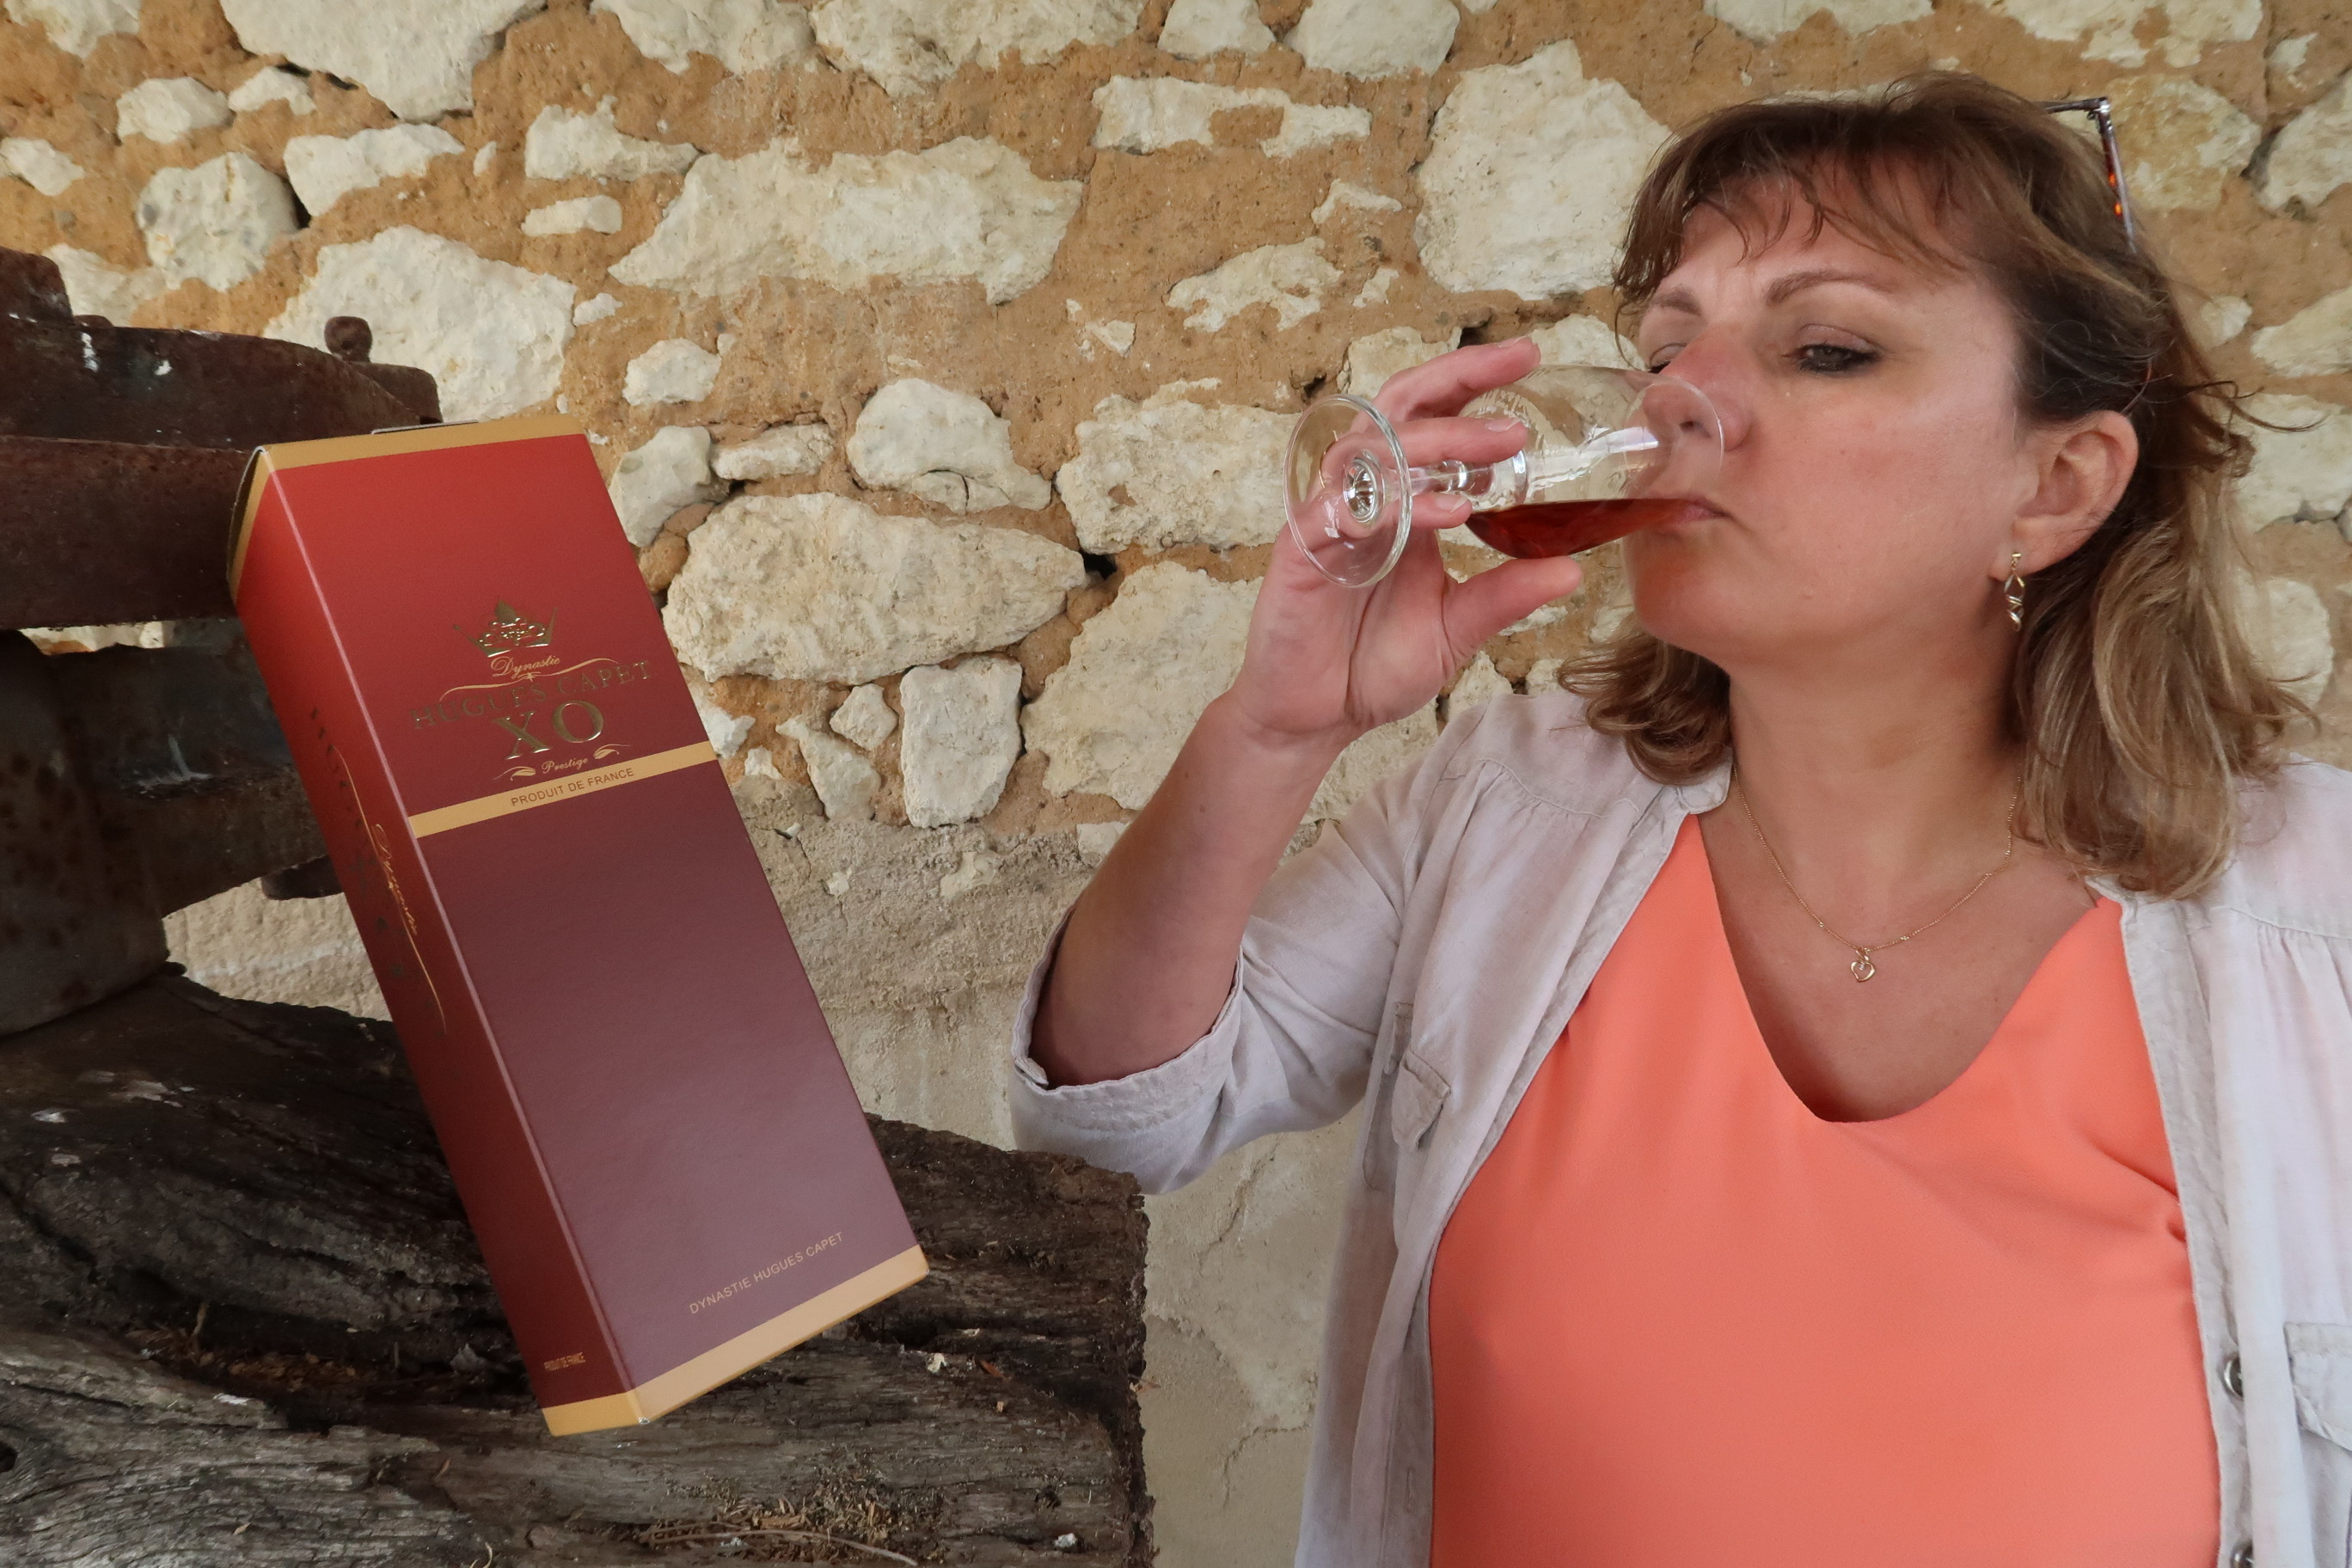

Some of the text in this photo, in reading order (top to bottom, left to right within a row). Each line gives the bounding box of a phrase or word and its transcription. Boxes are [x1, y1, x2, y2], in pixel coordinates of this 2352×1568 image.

[491, 654, 561, 680] Dynastie
[408, 659, 652, 730] HUGUES CAPET
[493, 699, 604, 760] XO
[511, 767, 634, 806] PRODUIT DE FRANCE
[541, 756, 589, 775] Prestige
[689, 1231, 843, 1314] DYNASTIE HUGUES CAPET
